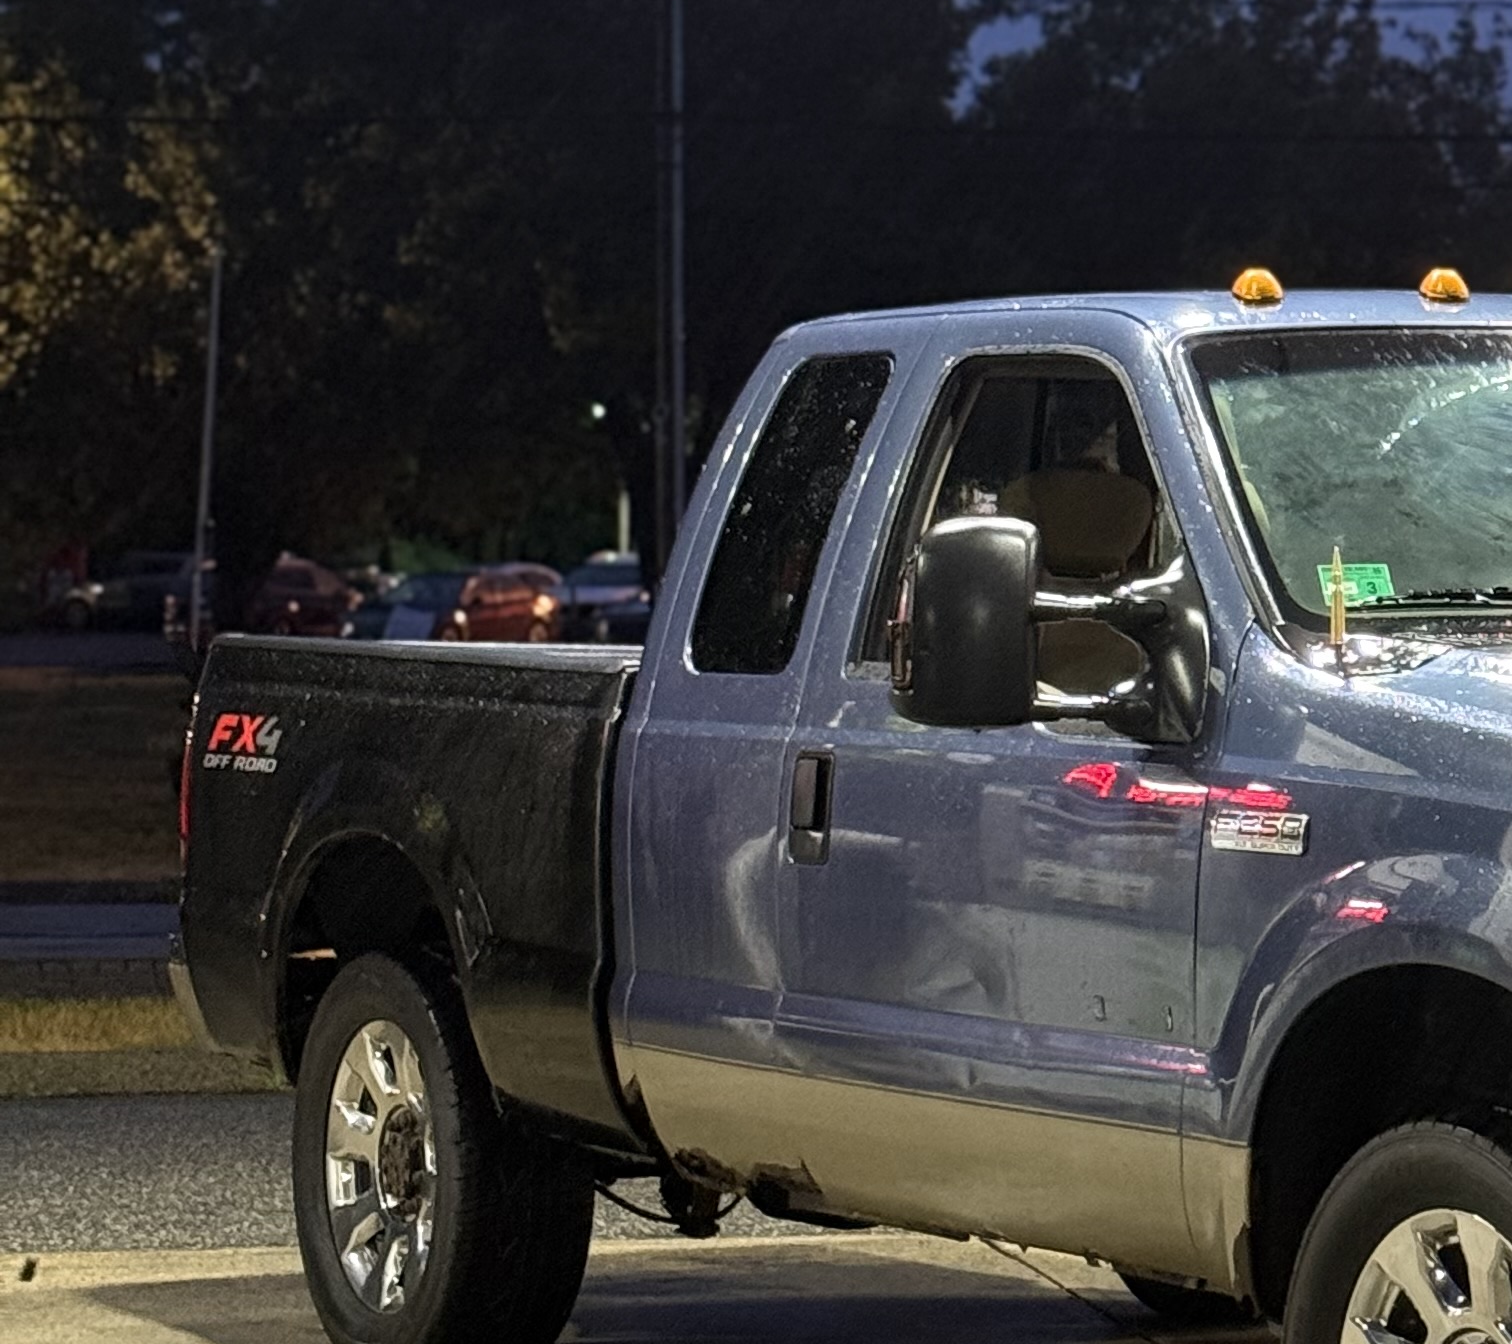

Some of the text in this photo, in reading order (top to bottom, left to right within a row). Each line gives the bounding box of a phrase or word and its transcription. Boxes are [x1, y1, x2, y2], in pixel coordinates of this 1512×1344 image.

[1366, 581, 1378, 595] 3
[207, 714, 282, 754] FX4
[203, 754, 278, 773] OFF ROAD
